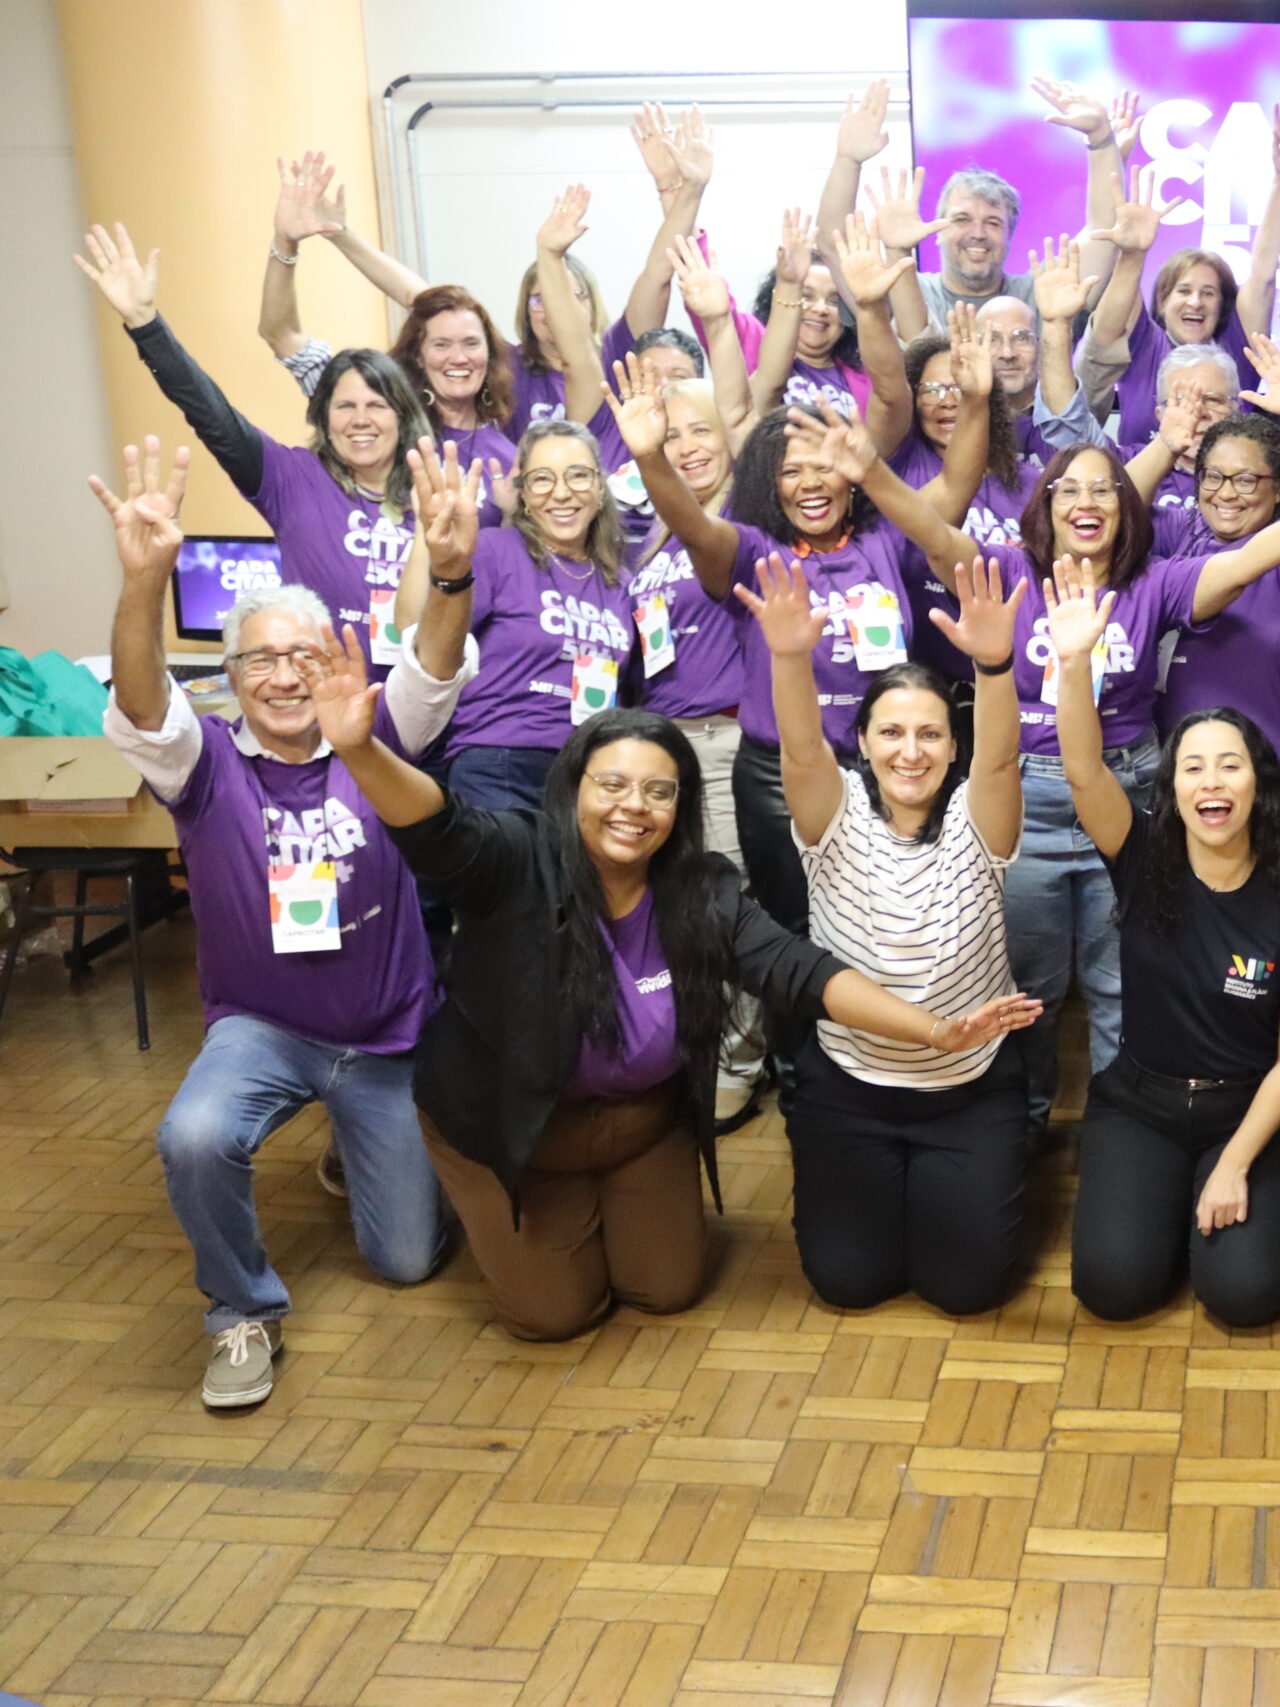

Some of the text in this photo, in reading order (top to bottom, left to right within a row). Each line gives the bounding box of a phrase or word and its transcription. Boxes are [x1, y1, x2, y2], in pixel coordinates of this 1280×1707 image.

[221, 559, 278, 574] CAPA
[540, 590, 622, 627] CAPA
[539, 607, 629, 652] CITAR
